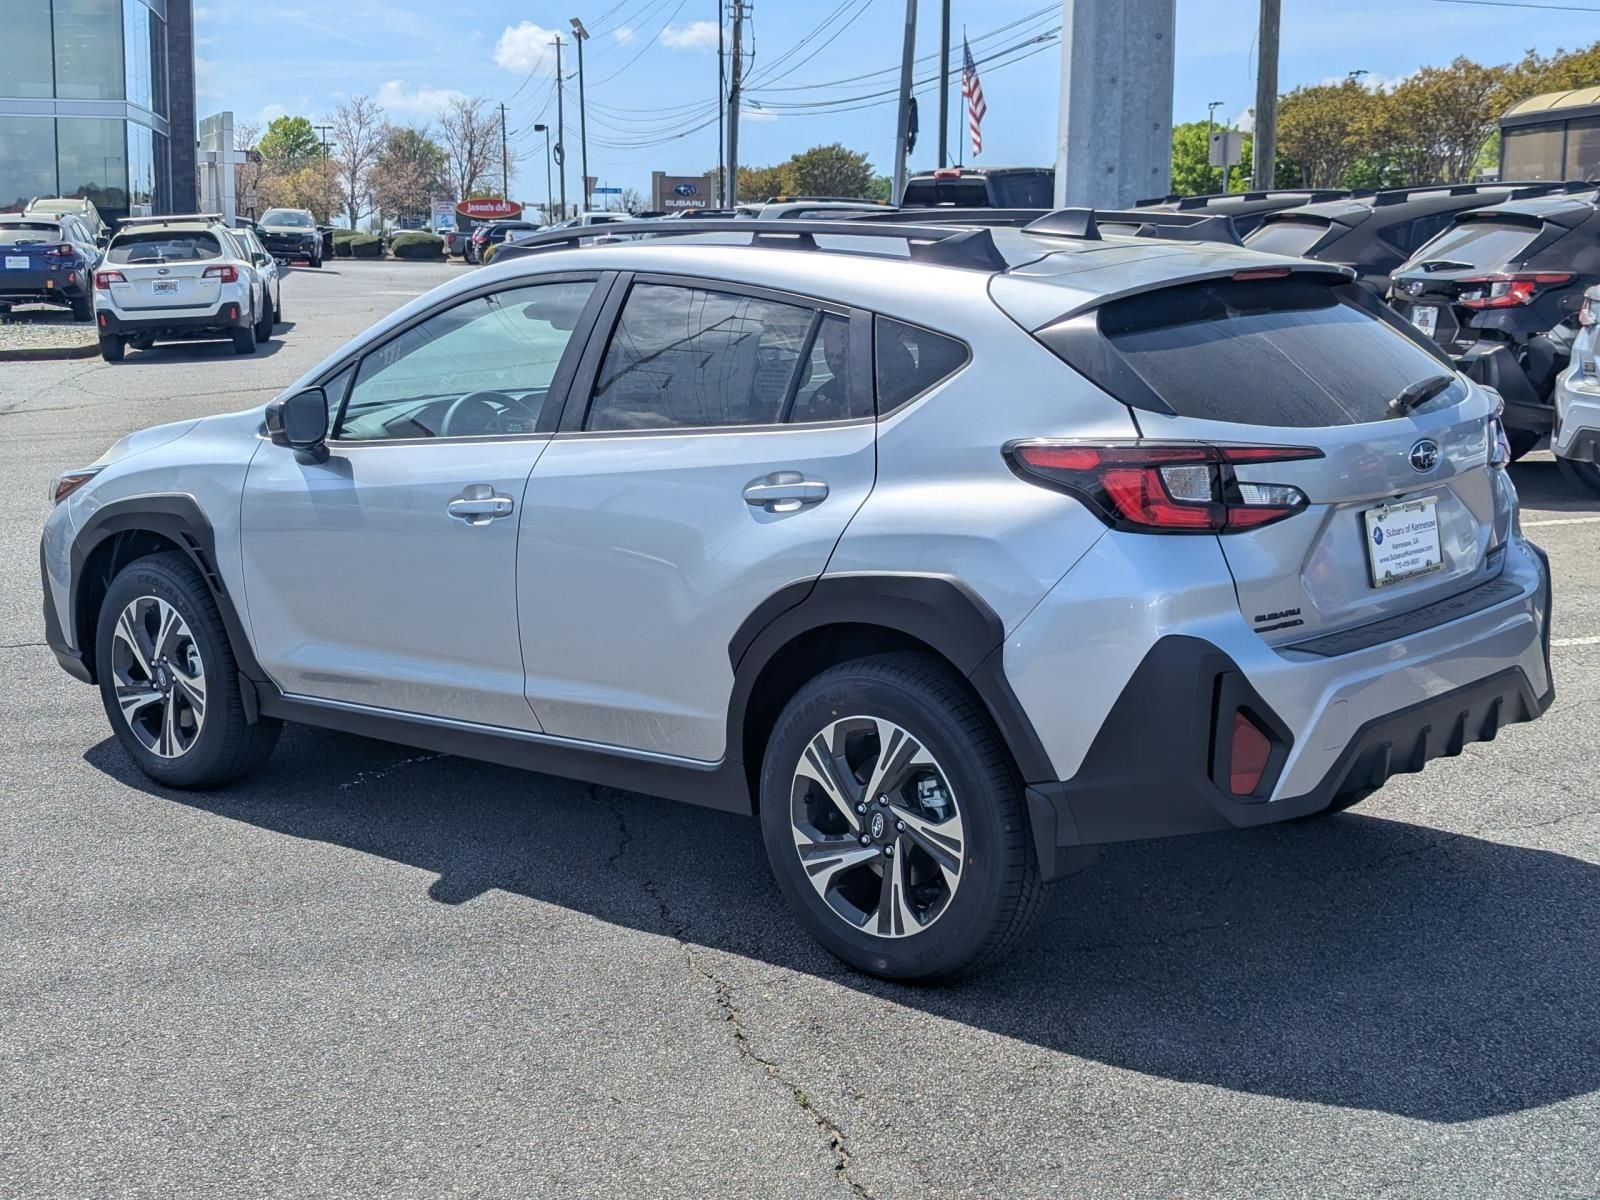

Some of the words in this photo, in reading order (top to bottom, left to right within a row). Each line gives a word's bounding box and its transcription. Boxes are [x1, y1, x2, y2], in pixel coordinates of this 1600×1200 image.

[467, 202, 494, 213] Jason's
[495, 202, 511, 212] deli
[664, 199, 706, 208] SUBARU
[1385, 527, 1405, 538] Subaru
[1405, 524, 1411, 533] of
[1411, 520, 1436, 531] Kennesaw
[1254, 607, 1301, 622] SUBARU
